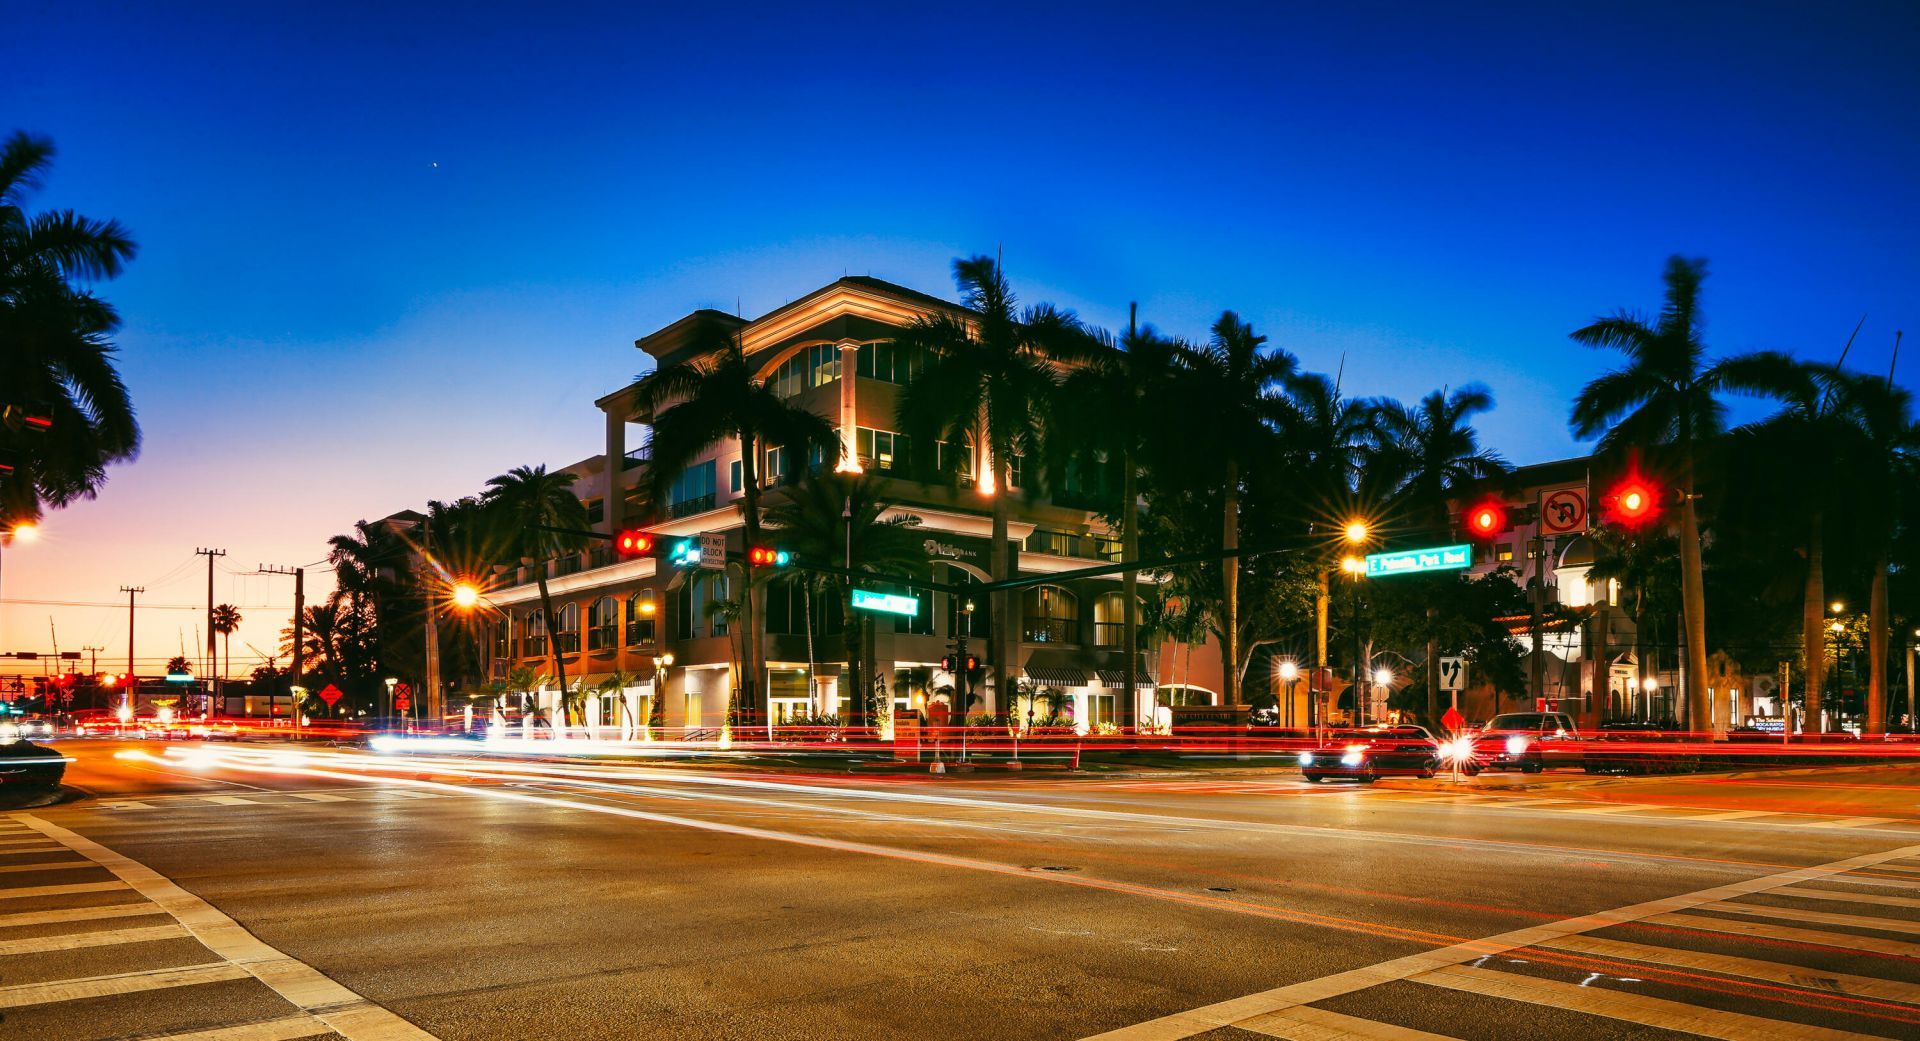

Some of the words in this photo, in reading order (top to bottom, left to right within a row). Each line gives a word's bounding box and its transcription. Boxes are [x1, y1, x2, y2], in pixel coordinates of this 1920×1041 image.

[701, 536, 711, 545] DO
[712, 537, 725, 547] NOT
[702, 548, 723, 557] BLOCK
[960, 548, 977, 557] BANK
[1369, 559, 1377, 572] E
[1419, 553, 1440, 567] Park
[1443, 550, 1465, 564] Road
